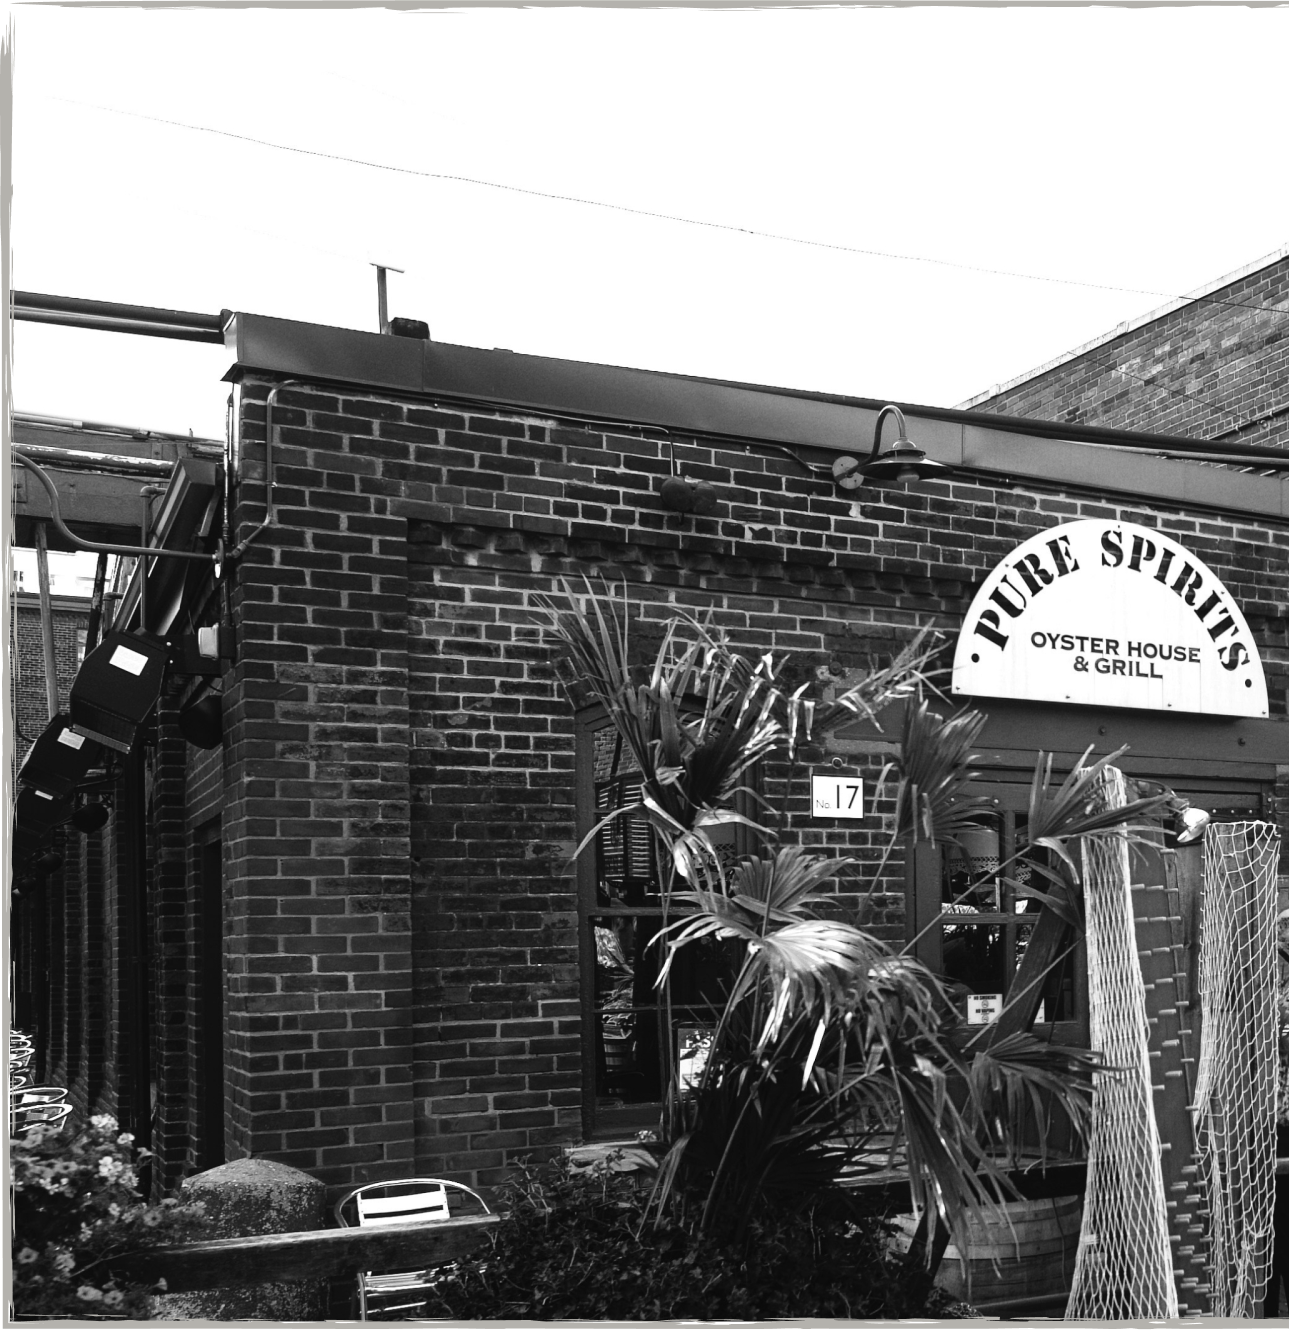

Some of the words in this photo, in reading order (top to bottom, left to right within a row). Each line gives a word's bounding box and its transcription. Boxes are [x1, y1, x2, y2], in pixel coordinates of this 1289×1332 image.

[973, 534, 1080, 652] PURE
[1100, 529, 1251, 671] SPIRITS
[1030, 631, 1120, 656] OYSTER
[1127, 641, 1201, 664] HOUSE
[1073, 655, 1089, 673] &
[1094, 657, 1164, 679] GRILL
[836, 784, 860, 809] 17
